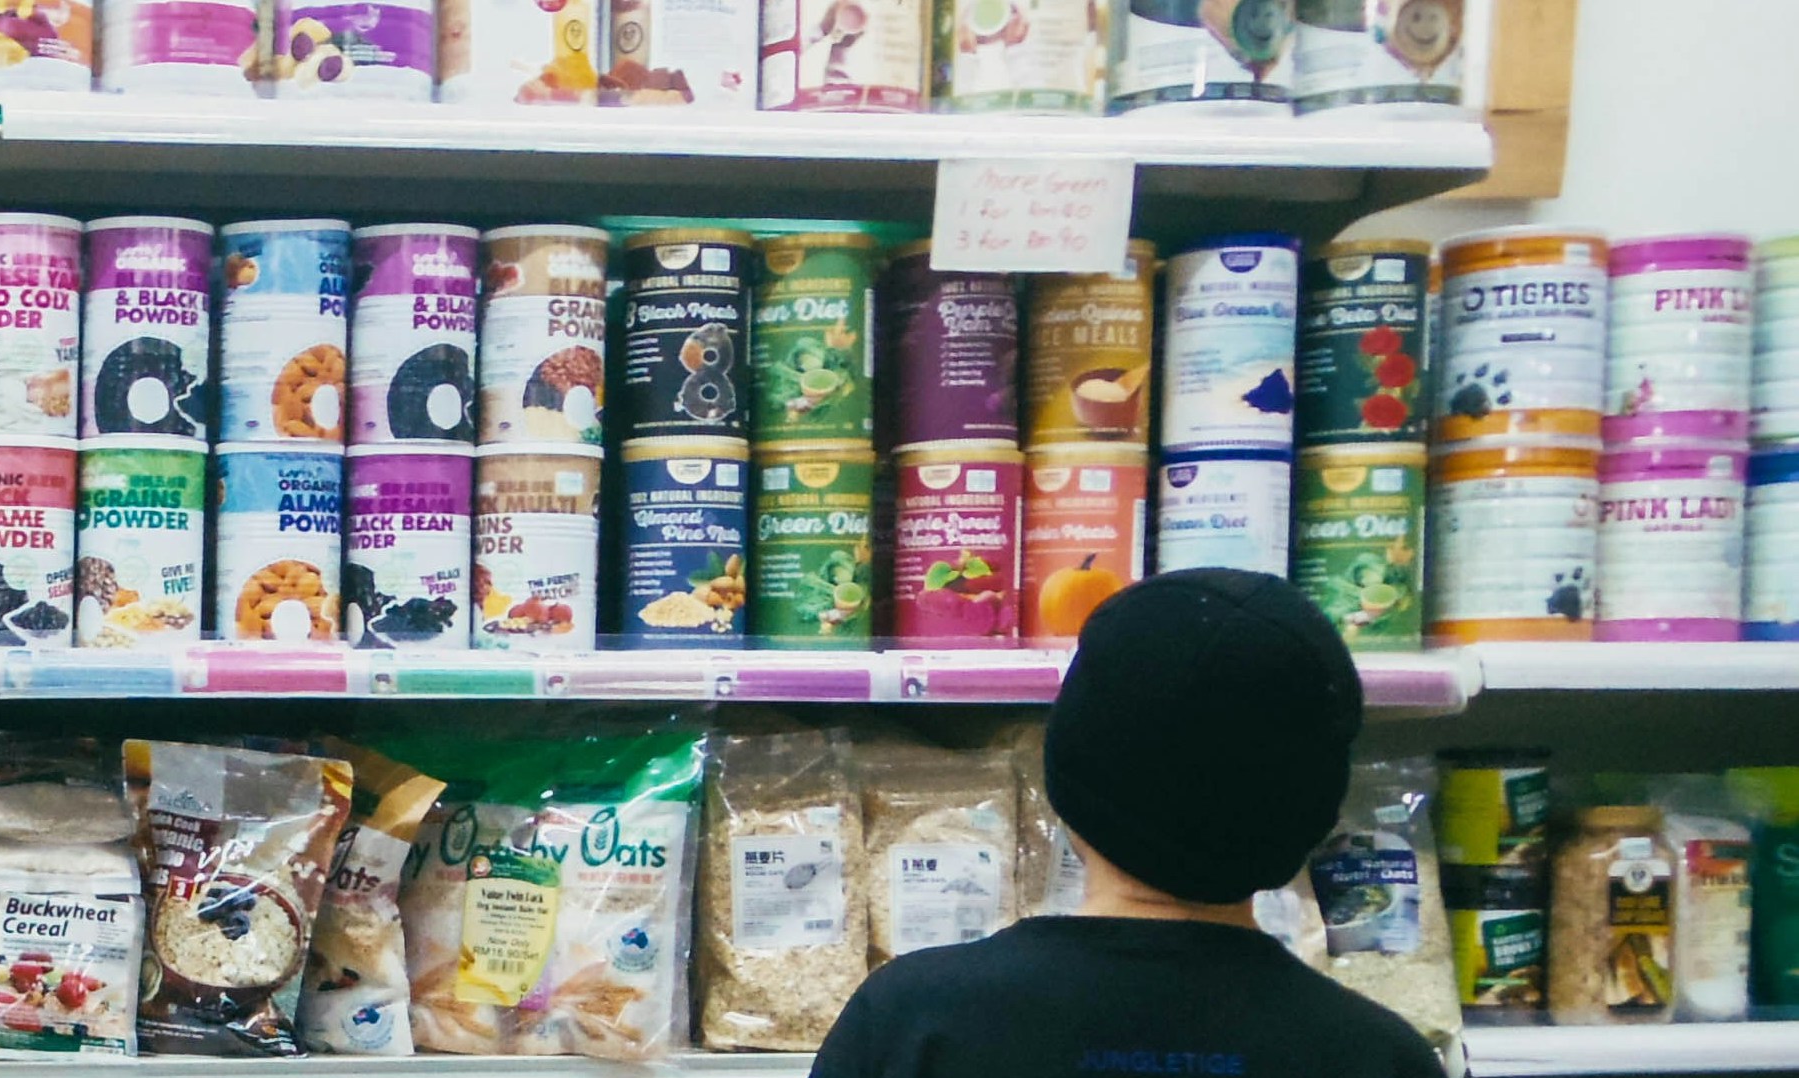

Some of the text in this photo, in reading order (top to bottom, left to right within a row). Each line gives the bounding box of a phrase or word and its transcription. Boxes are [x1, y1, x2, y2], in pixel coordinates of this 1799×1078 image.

[20, 290, 71, 311] COIX
[116, 291, 198, 309] & BLACK
[413, 296, 429, 312] &
[114, 307, 199, 326] POWDER
[94, 489, 182, 509] GRAINS
[1601, 498, 1669, 522] PINK
[93, 510, 189, 531] POWDER
[402, 515, 454, 532] BEAN
[4, 896, 117, 925] Buckwheat
[2, 915, 70, 938] Cereal
